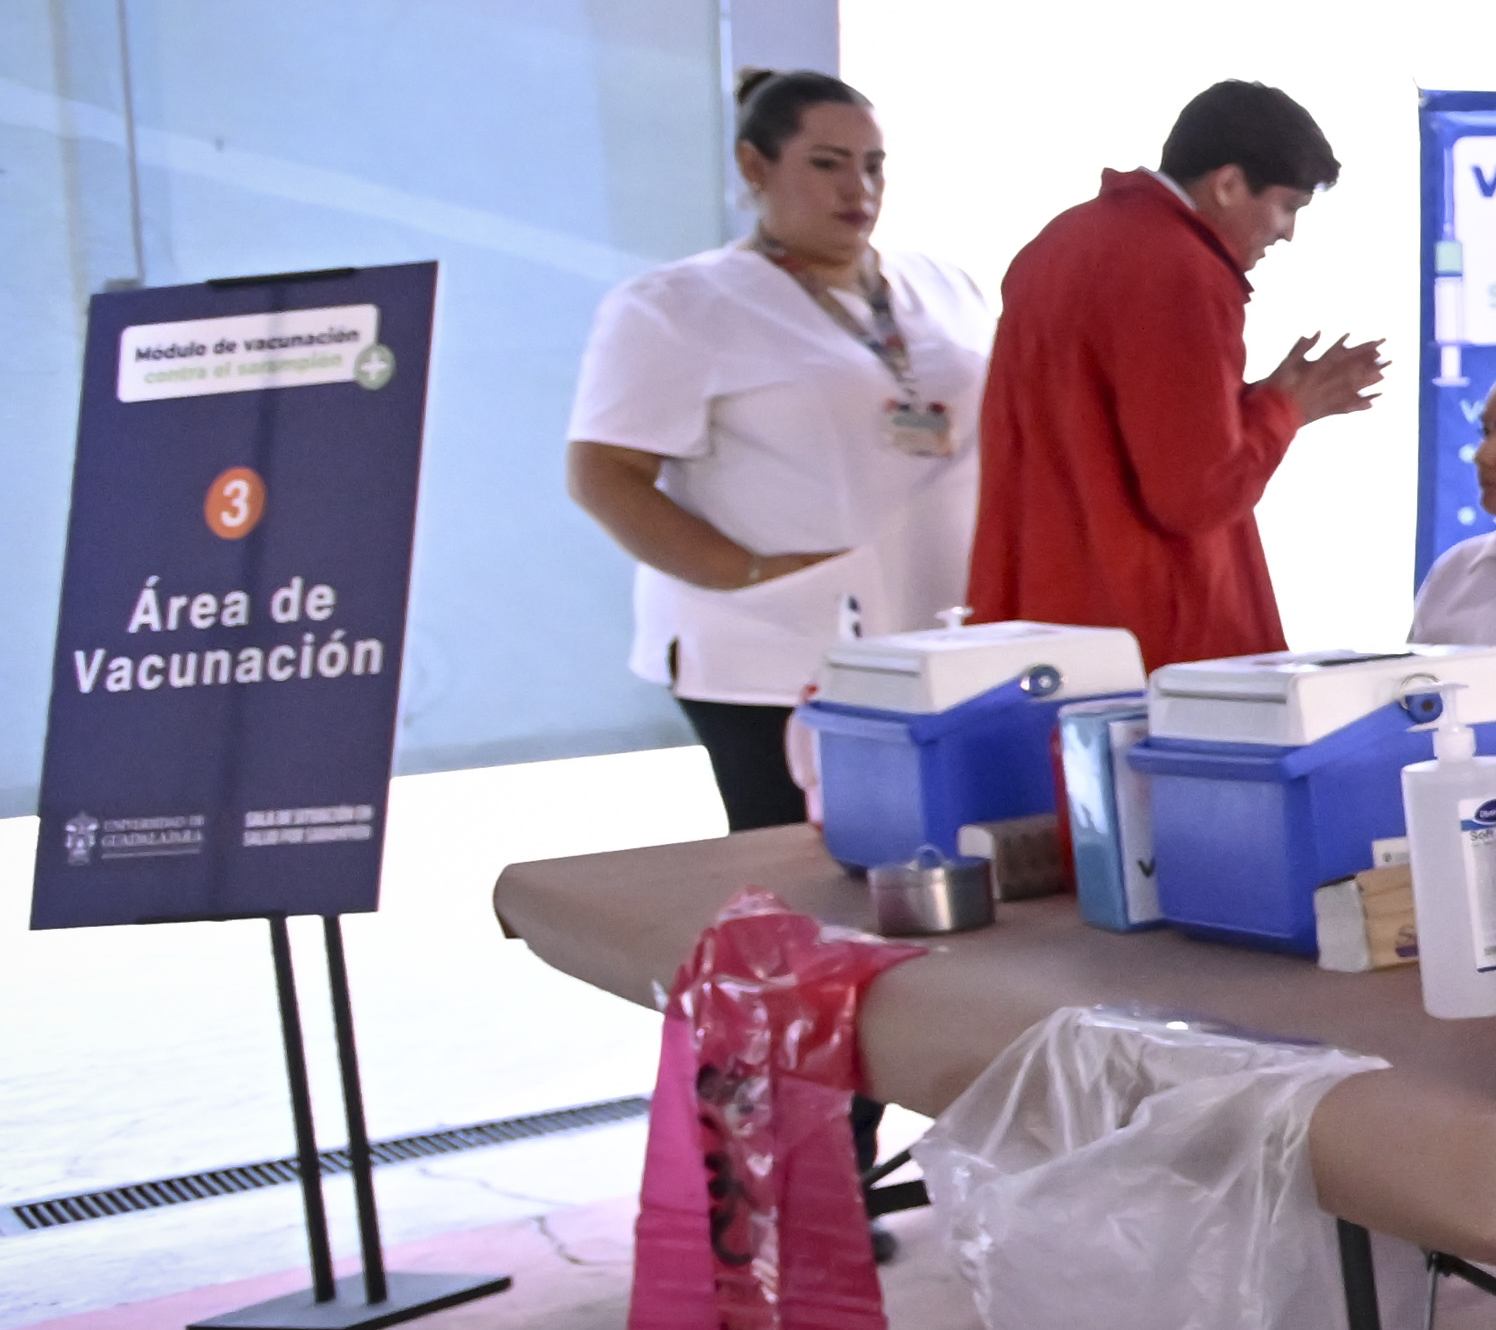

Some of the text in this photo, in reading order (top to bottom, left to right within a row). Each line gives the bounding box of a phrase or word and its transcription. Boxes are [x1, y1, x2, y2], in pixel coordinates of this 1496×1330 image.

[135, 326, 359, 362] Módulo de vacunación
[144, 364, 206, 384] contra
[220, 478, 249, 527] 3
[127, 575, 336, 634] Área de
[73, 627, 384, 695] Vacunación
